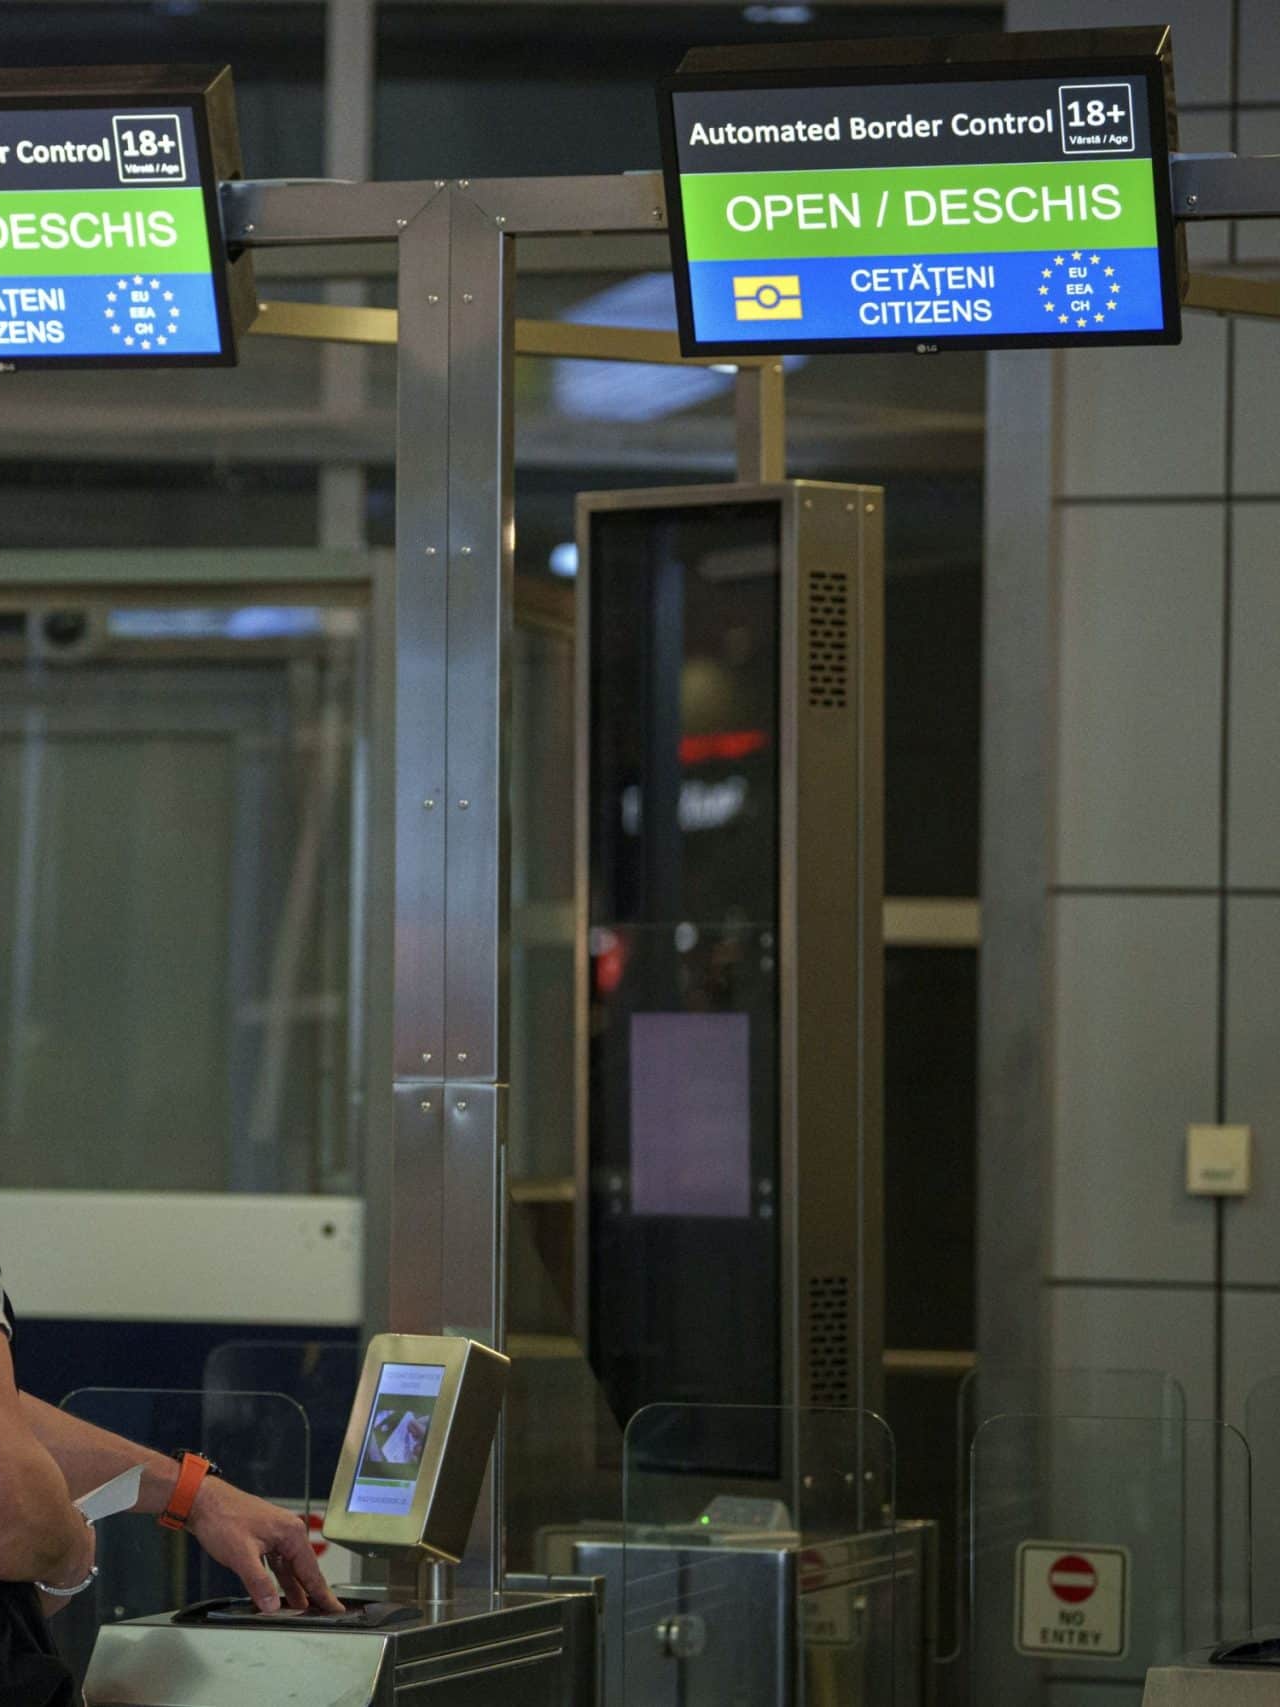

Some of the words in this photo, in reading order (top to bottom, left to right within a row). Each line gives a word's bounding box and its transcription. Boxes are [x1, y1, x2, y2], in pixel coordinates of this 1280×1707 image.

[1067, 100, 1126, 127] 18+
[690, 117, 840, 145] Automated
[850, 114, 941, 139] Border
[952, 109, 1053, 136] Control
[121, 129, 176, 157] 18+
[1108, 134, 1129, 145] Age
[17, 138, 110, 163] Control
[727, 193, 861, 232] OPEN
[877, 191, 889, 228] /
[905, 184, 1122, 226] DESCHIS
[1069, 267, 1087, 278] EU
[131, 290, 149, 303] EU
[1066, 284, 1093, 294] EEA
[129, 306, 156, 319] EEA
[859, 299, 993, 325] CITIZENS
[1071, 301, 1090, 311] CH
[1058, 1610, 1085, 1627] NO
[1039, 1627, 1103, 1645] ENTRY
